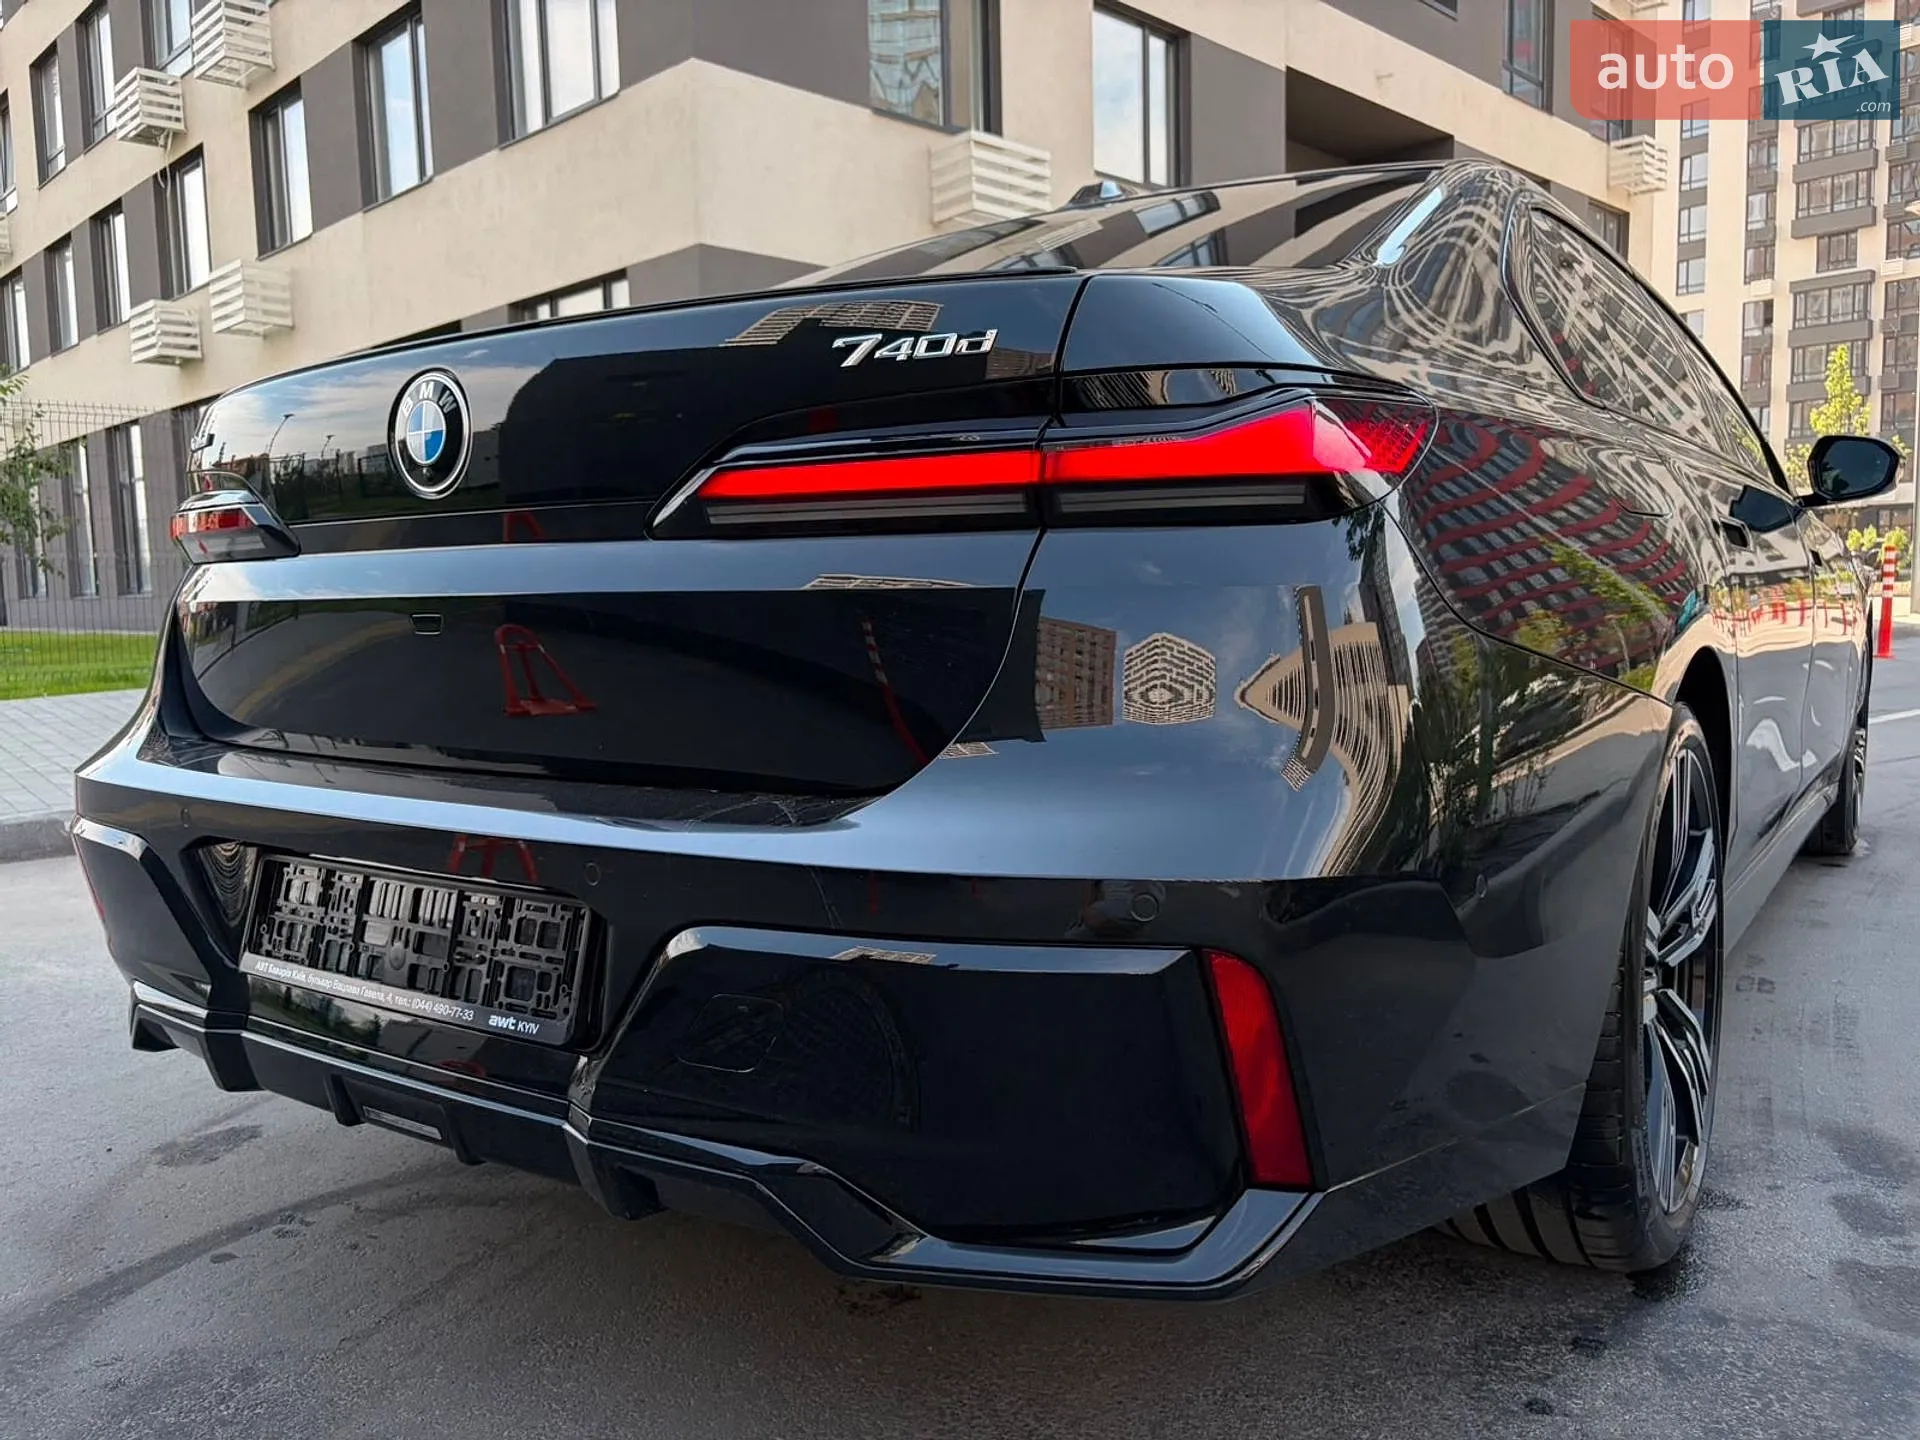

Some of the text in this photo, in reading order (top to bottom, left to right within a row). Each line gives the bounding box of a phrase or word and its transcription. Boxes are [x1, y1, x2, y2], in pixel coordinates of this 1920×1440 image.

[832, 328, 998, 367] 740d
[401, 381, 457, 417] BMW
[433, 1002, 474, 1021] 490-77-33
[488, 1014, 540, 1035] awt KYIV
